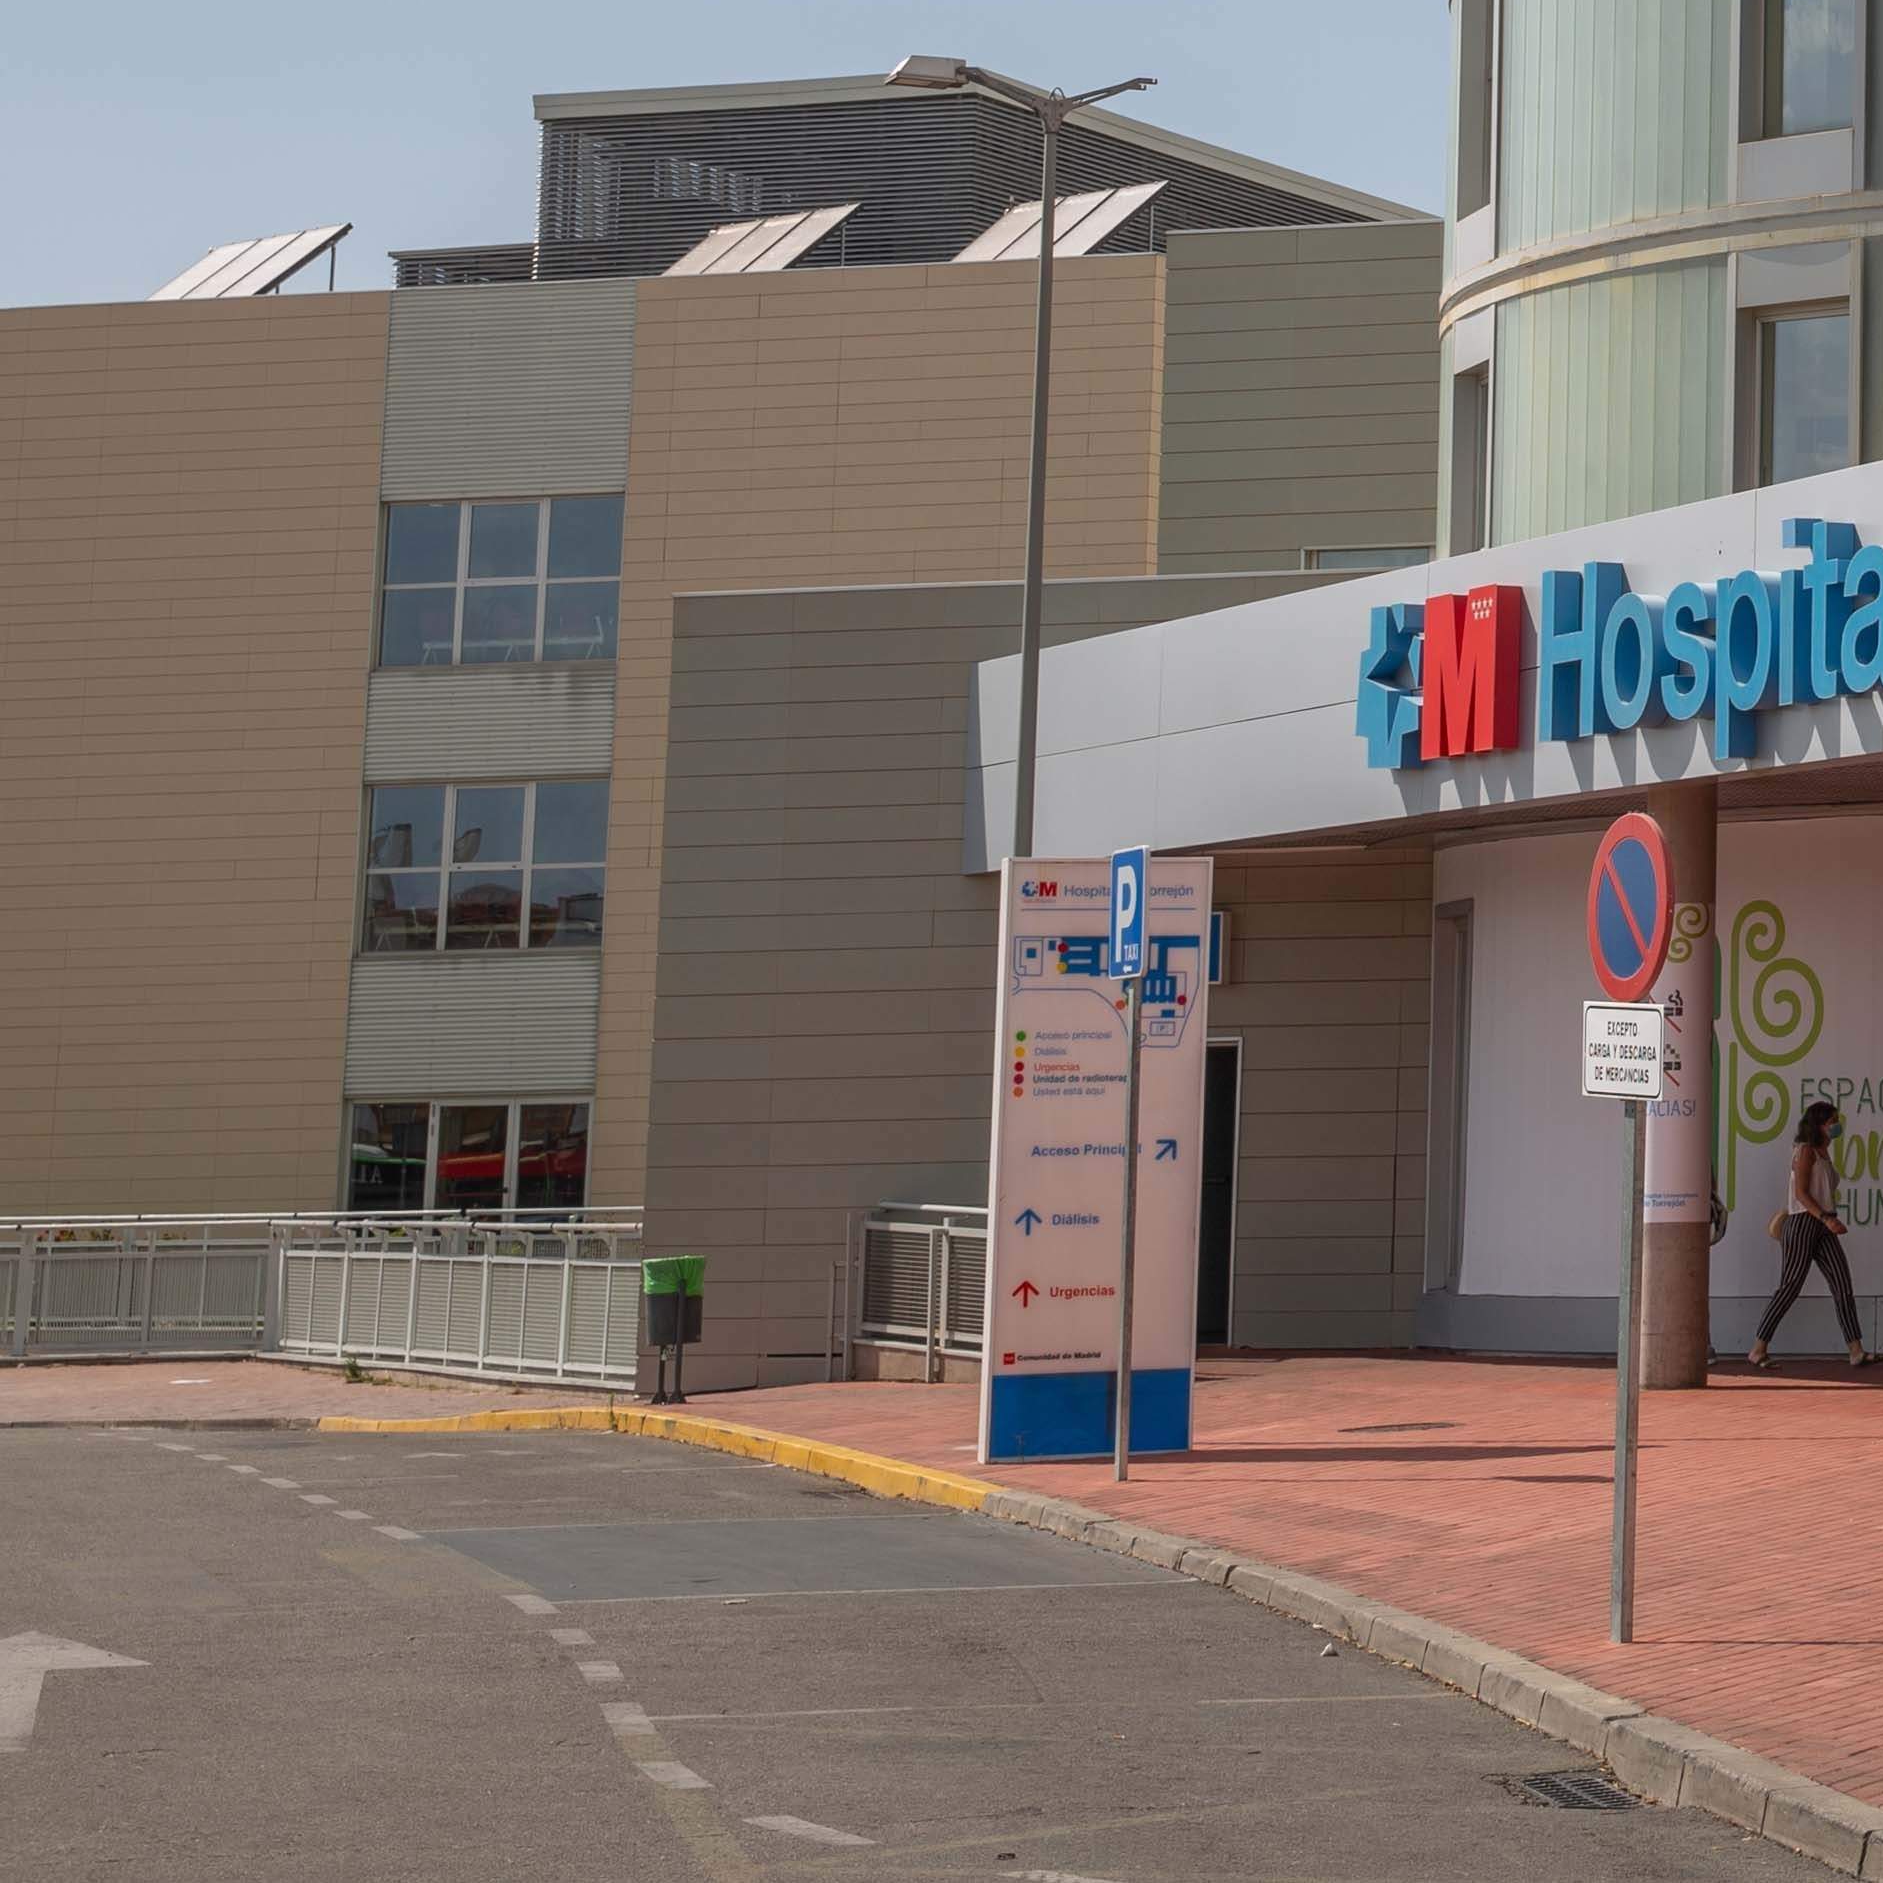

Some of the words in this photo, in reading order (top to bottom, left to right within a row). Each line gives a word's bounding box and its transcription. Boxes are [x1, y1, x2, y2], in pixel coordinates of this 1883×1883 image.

[1064, 884, 1111, 900] Hospita
[1150, 885, 1194, 899] orrejón
[1115, 865, 1138, 963] P
[1124, 944, 1139, 961] TAXI
[1034, 1031, 1070, 1040] Acceso
[1072, 1030, 1112, 1042] principal
[1607, 1021, 1638, 1037] EXCEPTO
[1588, 1043, 1610, 1058] CARGA
[1613, 1044, 1618, 1059] Y
[1620, 1044, 1657, 1062] DESCARGA
[1034, 1062, 1080, 1073] Urgencias
[1594, 1065, 1603, 1081] DE
[1033, 1074, 1066, 1083] Unidad
[1068, 1074, 1080, 1083] de
[1033, 1087, 1061, 1096] Usted
[1646, 1099, 1697, 1117] ACIAS!
[1031, 1145, 1080, 1157] Acceso
[1051, 1212, 1100, 1226] Diálisis
[1049, 1284, 1116, 1300] Urgencias
[1017, 1352, 1060, 1362] Comunidad
[1062, 1352, 1072, 1360] de
[1074, 1350, 1102, 1359] Madrid
